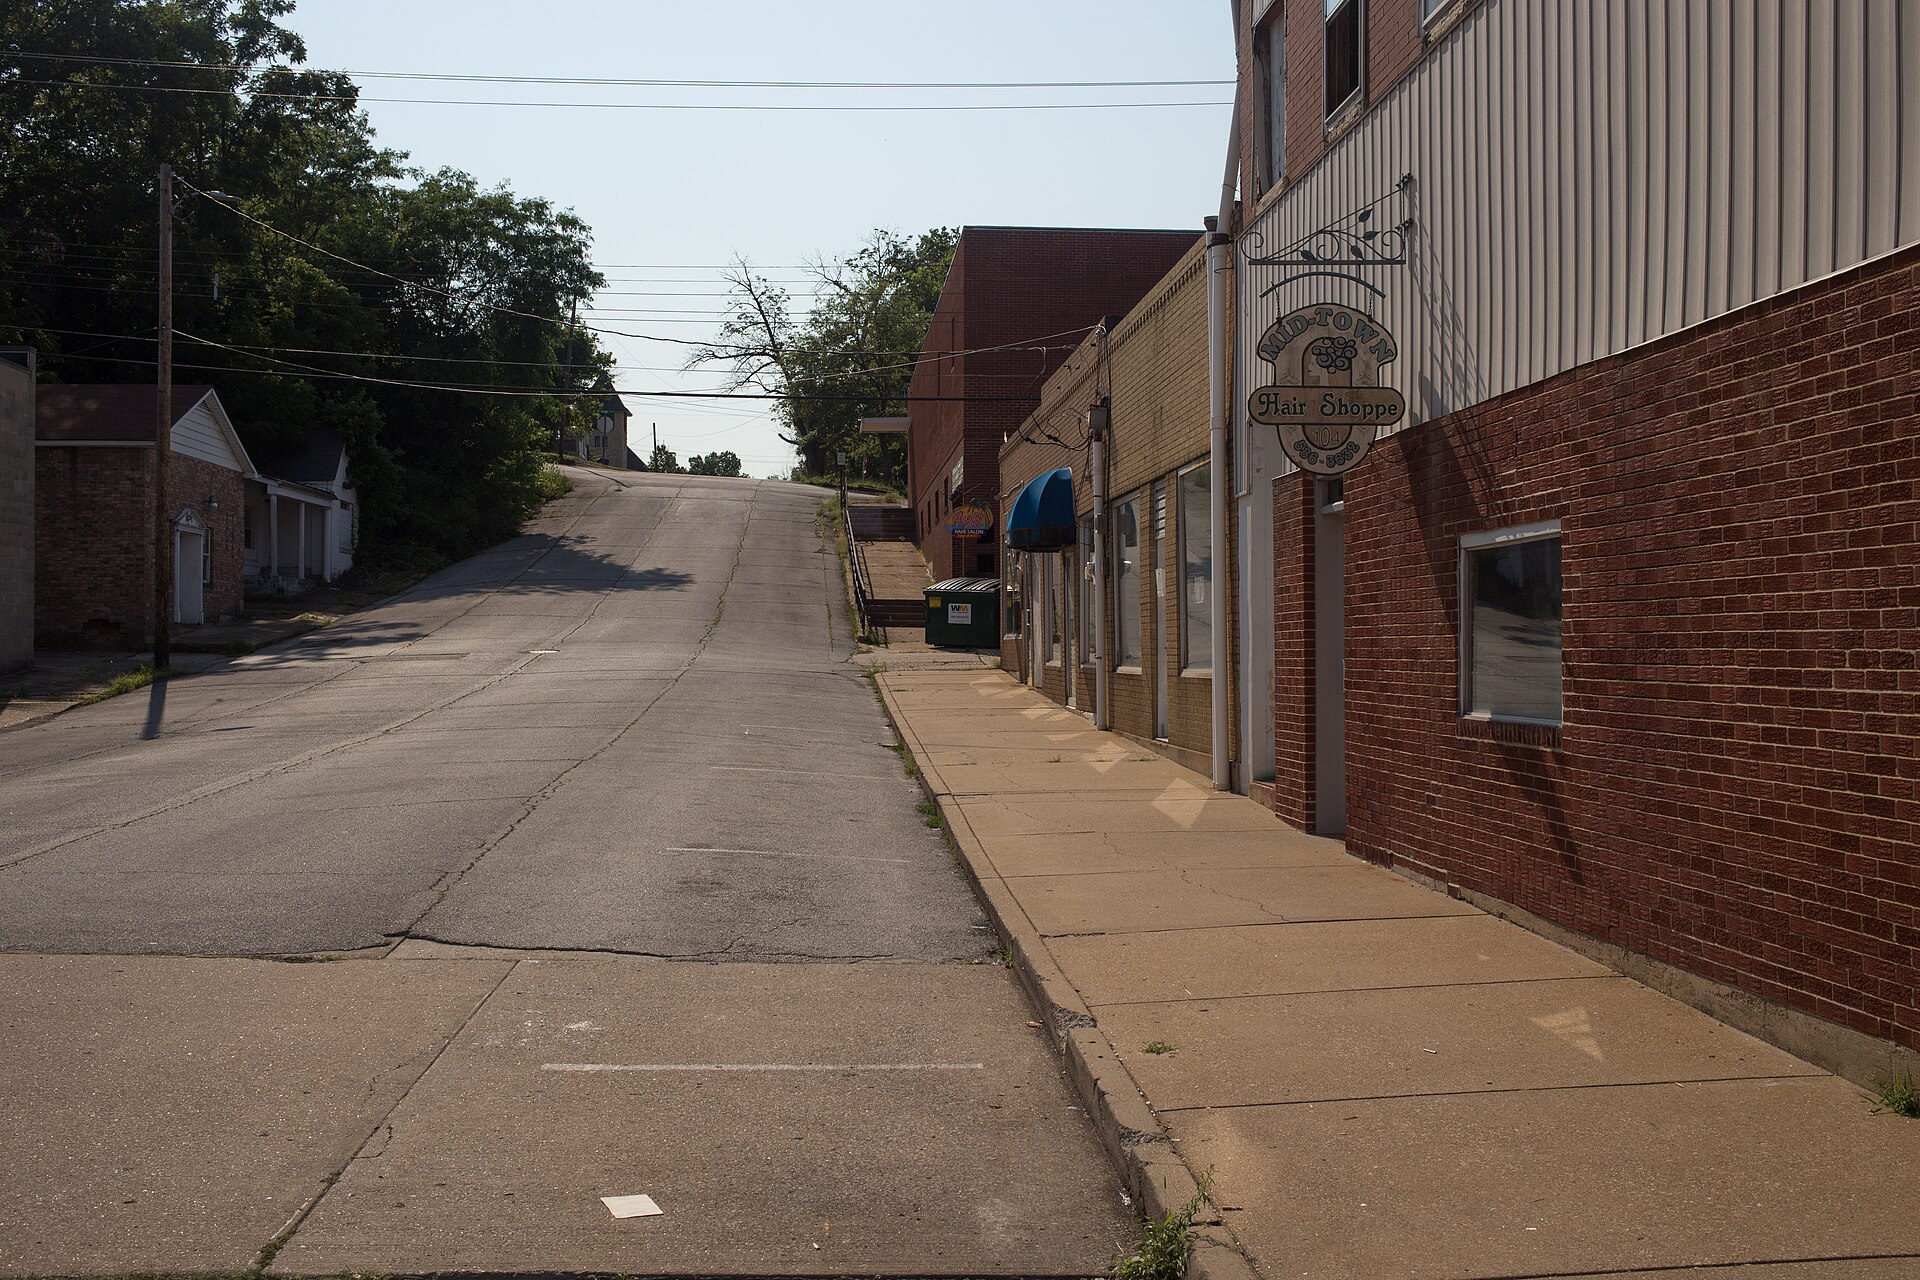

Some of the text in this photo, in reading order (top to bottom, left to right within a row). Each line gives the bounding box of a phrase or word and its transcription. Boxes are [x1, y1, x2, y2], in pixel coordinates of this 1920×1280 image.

[1260, 307, 1395, 362] MID-TOWN
[1257, 392, 1399, 421] Hair Shoppe
[1312, 427, 1341, 447] 104
